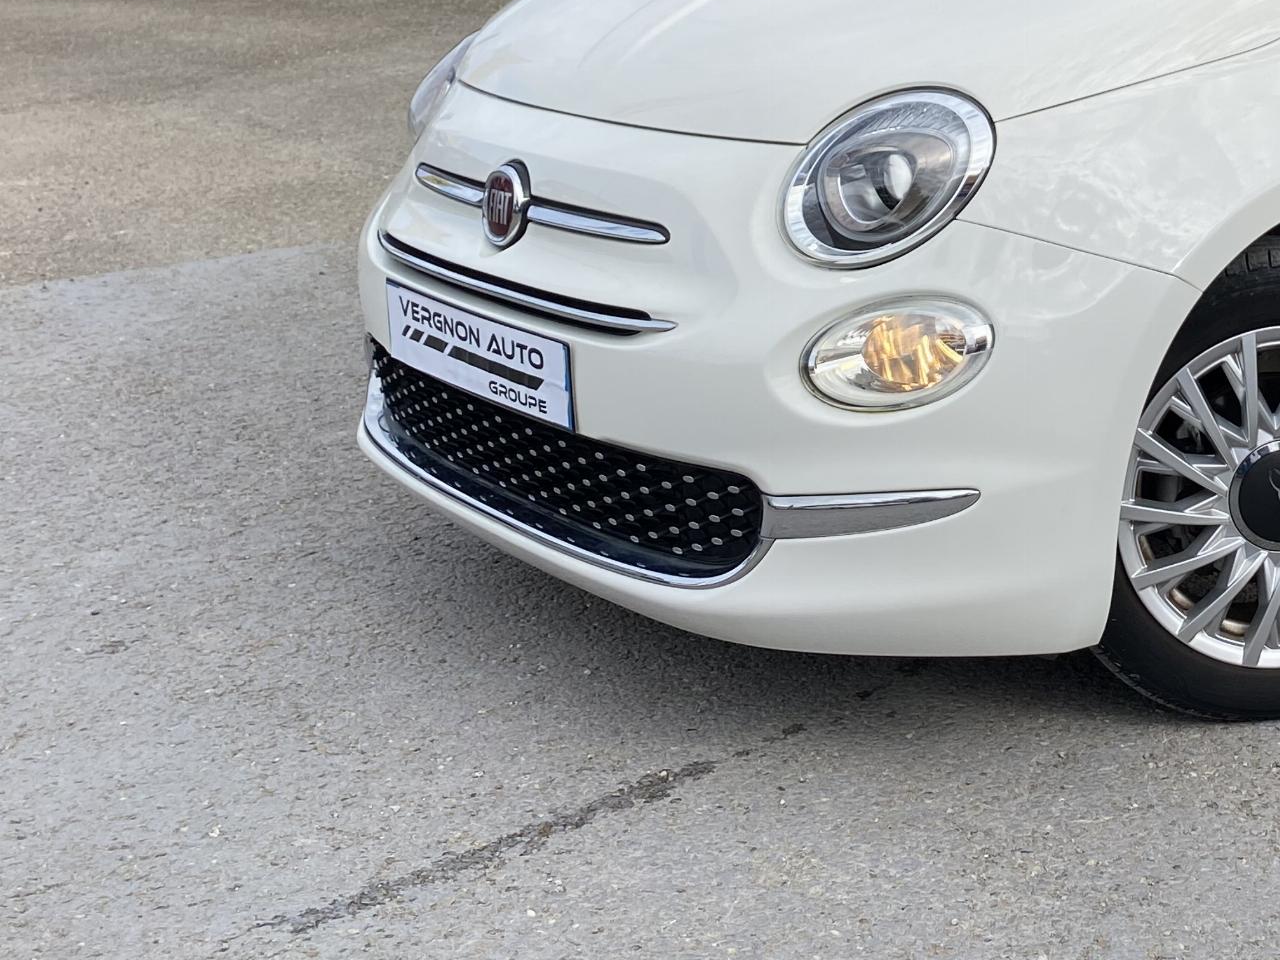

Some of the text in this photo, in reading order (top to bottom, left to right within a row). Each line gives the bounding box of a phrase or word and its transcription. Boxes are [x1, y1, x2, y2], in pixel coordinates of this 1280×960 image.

[488, 188, 513, 226] FIAT
[398, 295, 544, 370] VERGNON AUTO
[488, 380, 548, 414] GROUPE
